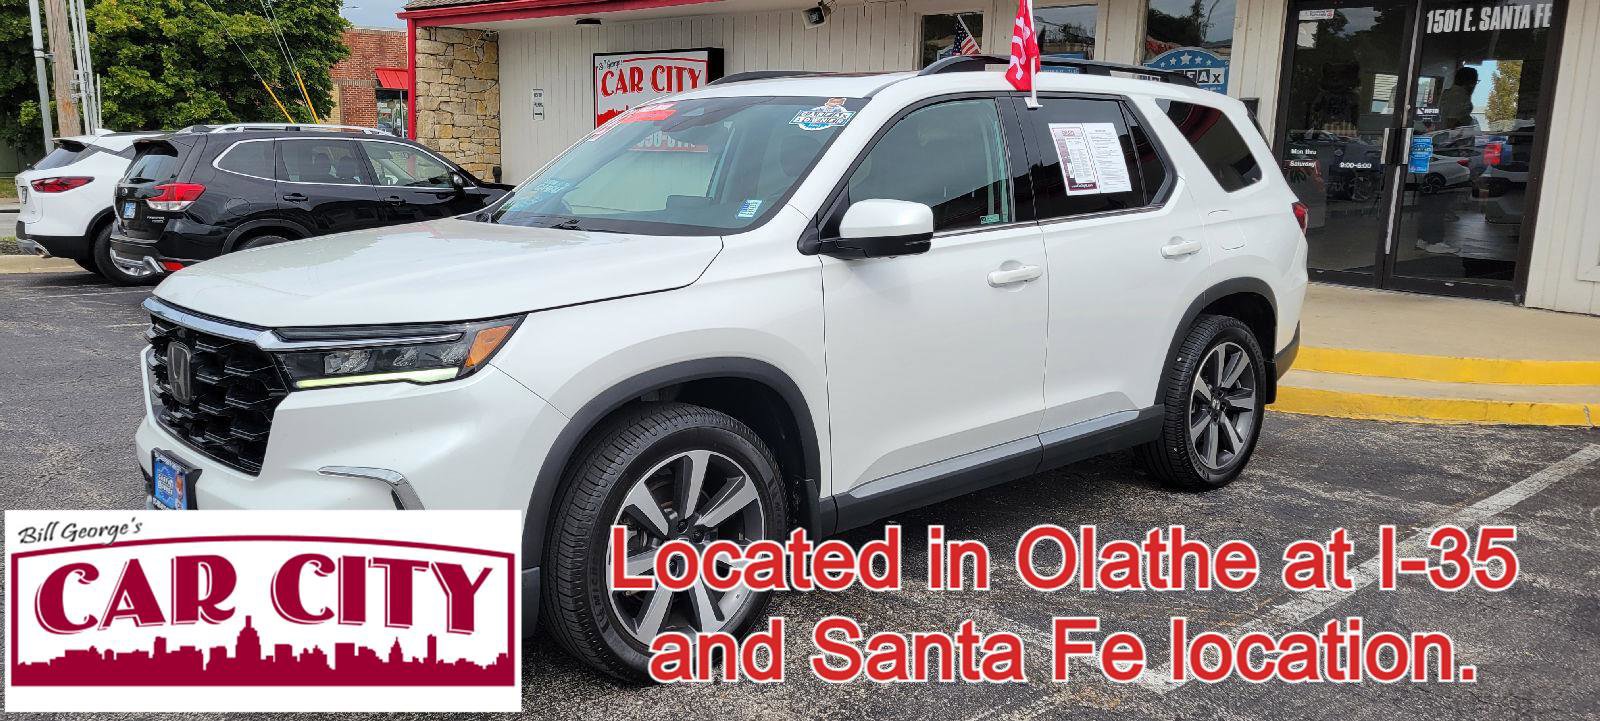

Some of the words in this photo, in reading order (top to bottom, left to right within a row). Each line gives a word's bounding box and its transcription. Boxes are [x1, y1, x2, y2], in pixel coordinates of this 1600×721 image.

[1426, 9, 1462, 33] 1501
[1463, 8, 1476, 31] E.
[1479, 5, 1531, 30] SANTA
[1533, 4, 1553, 28] FE
[601, 66, 644, 97] CAR
[650, 64, 702, 93] CITY
[1290, 160, 1316, 168] Saturday
